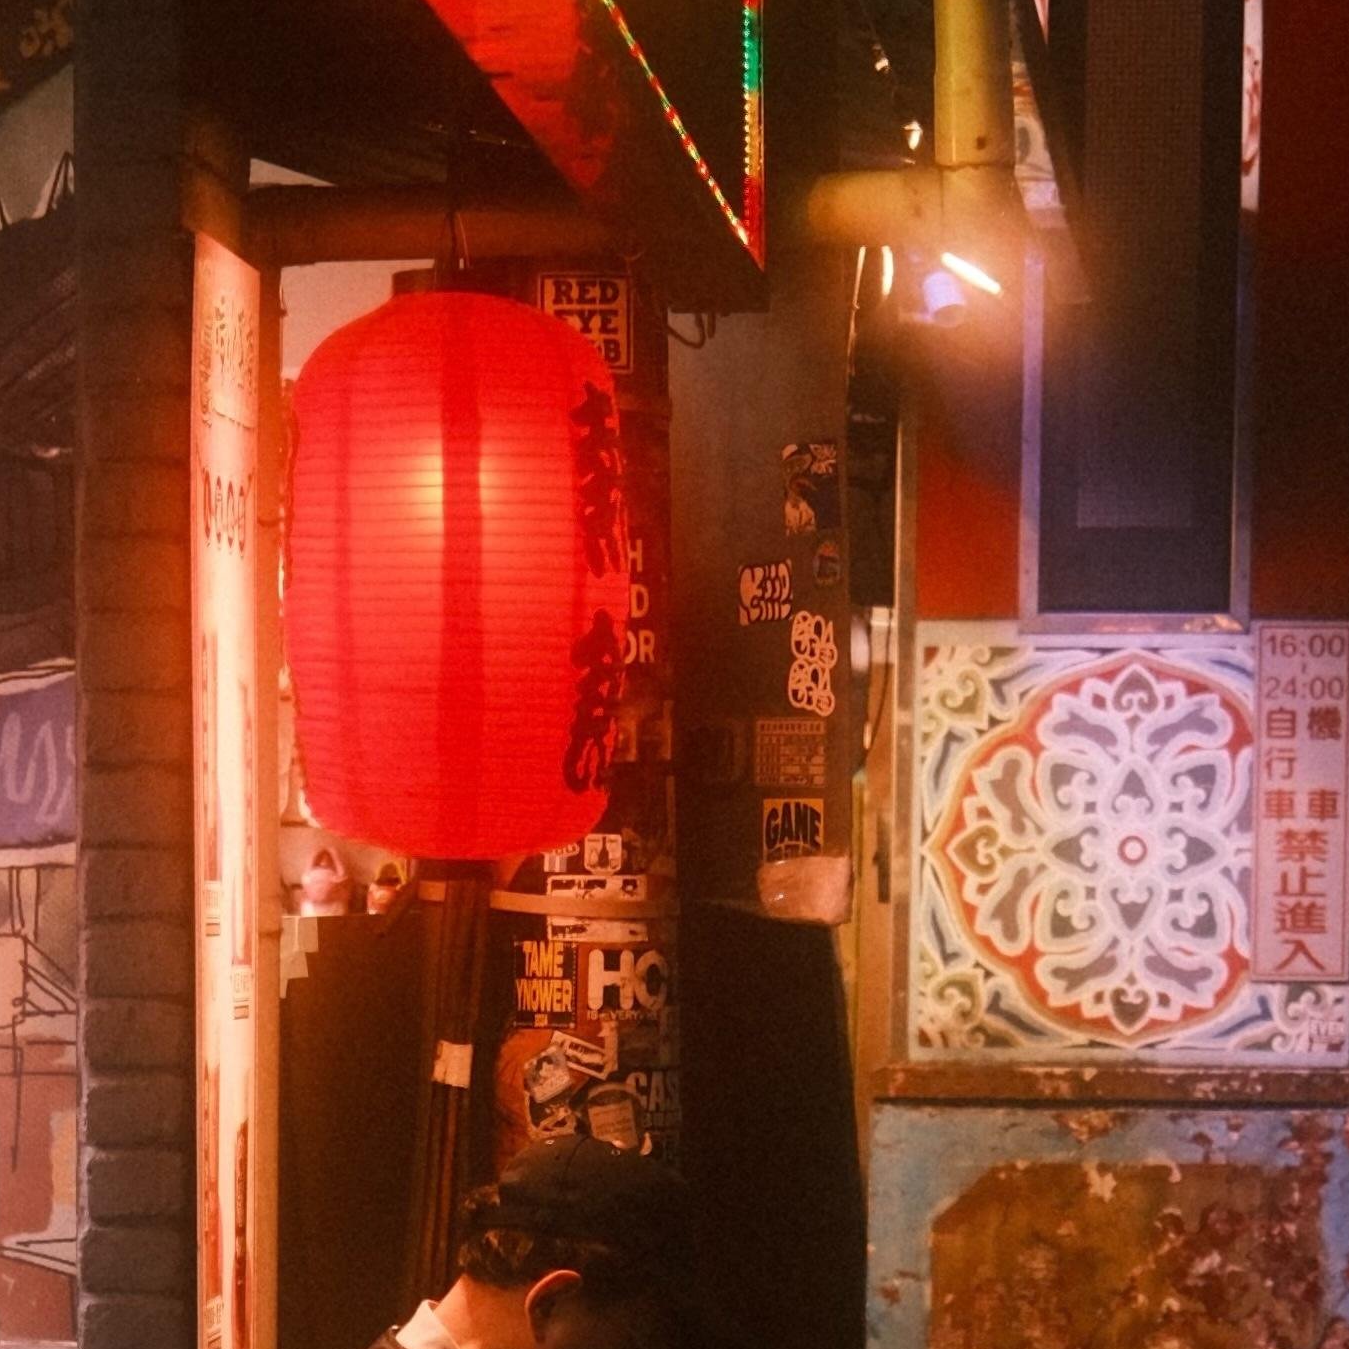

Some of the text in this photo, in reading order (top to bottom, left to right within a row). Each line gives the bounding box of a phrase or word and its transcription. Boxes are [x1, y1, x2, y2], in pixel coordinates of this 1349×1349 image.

[552, 280, 620, 305] RED
[553, 310, 620, 335] YE
[1265, 634, 1344, 658] 16:00
[1264, 676, 1345, 700] 24:00
[1264, 706, 1298, 821] 自行車
[1306, 706, 1343, 820] 機車
[1274, 829, 1328, 971] 禁止進入
